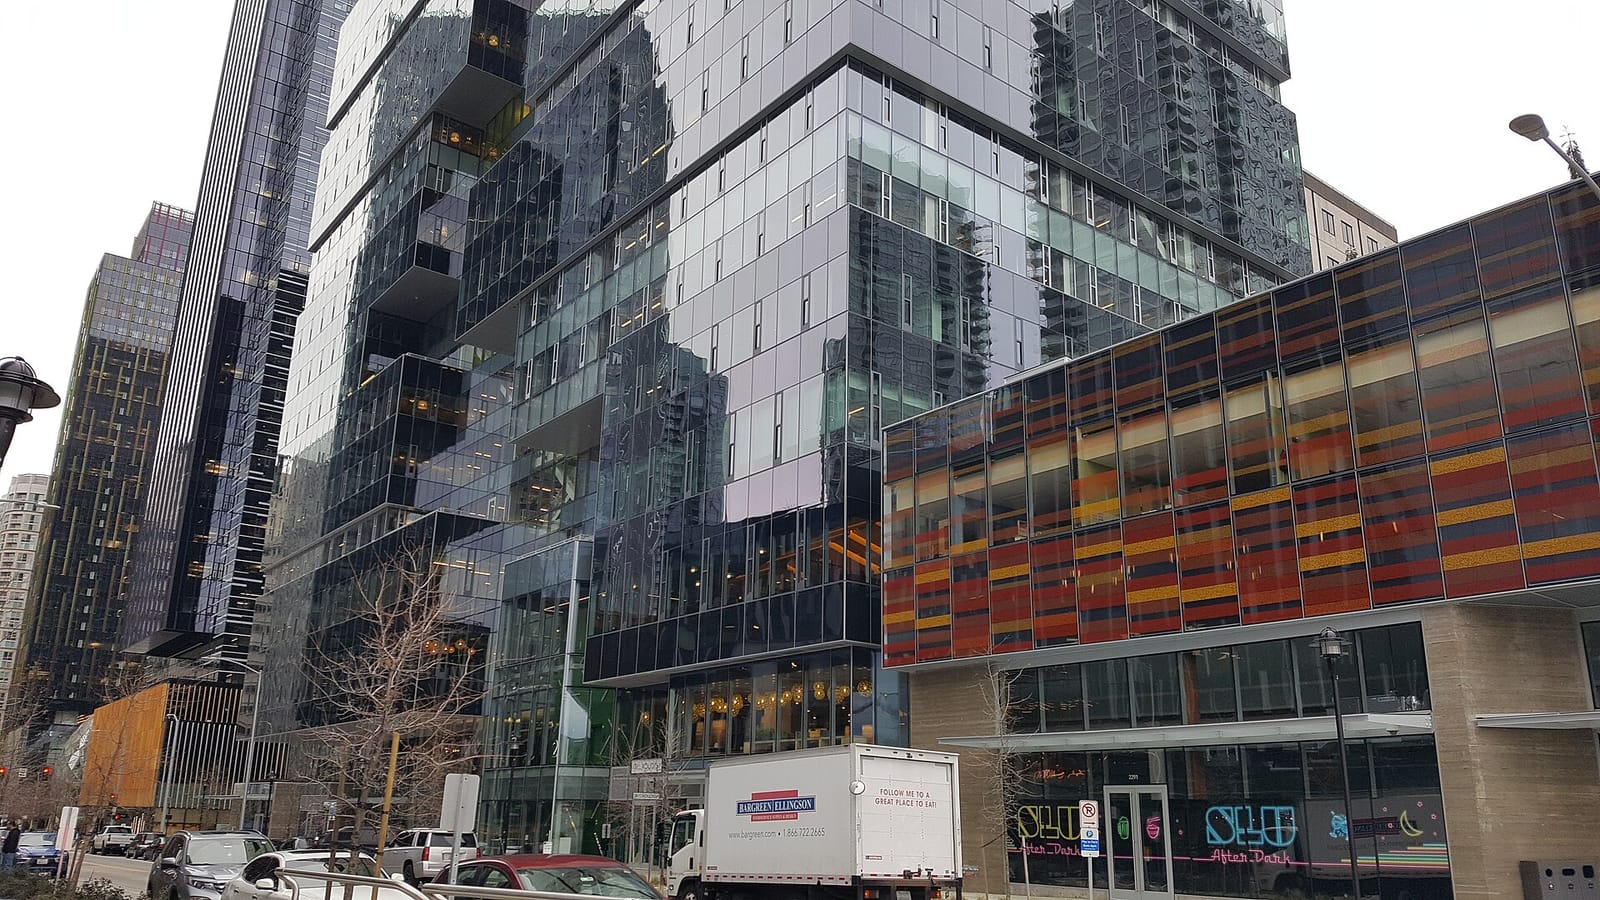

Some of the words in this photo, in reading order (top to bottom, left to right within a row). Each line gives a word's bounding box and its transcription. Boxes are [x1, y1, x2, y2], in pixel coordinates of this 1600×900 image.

[739, 802, 772, 813] BARGREEN
[774, 799, 812, 811] ELLINGSON
[896, 799, 914, 807] PLACE
[728, 829, 777, 841] www.bargreen.com
[783, 827, 825, 837] 1.866.722.2665
[1210, 848, 1248, 865] After
[1247, 849, 1291, 863] Dark
